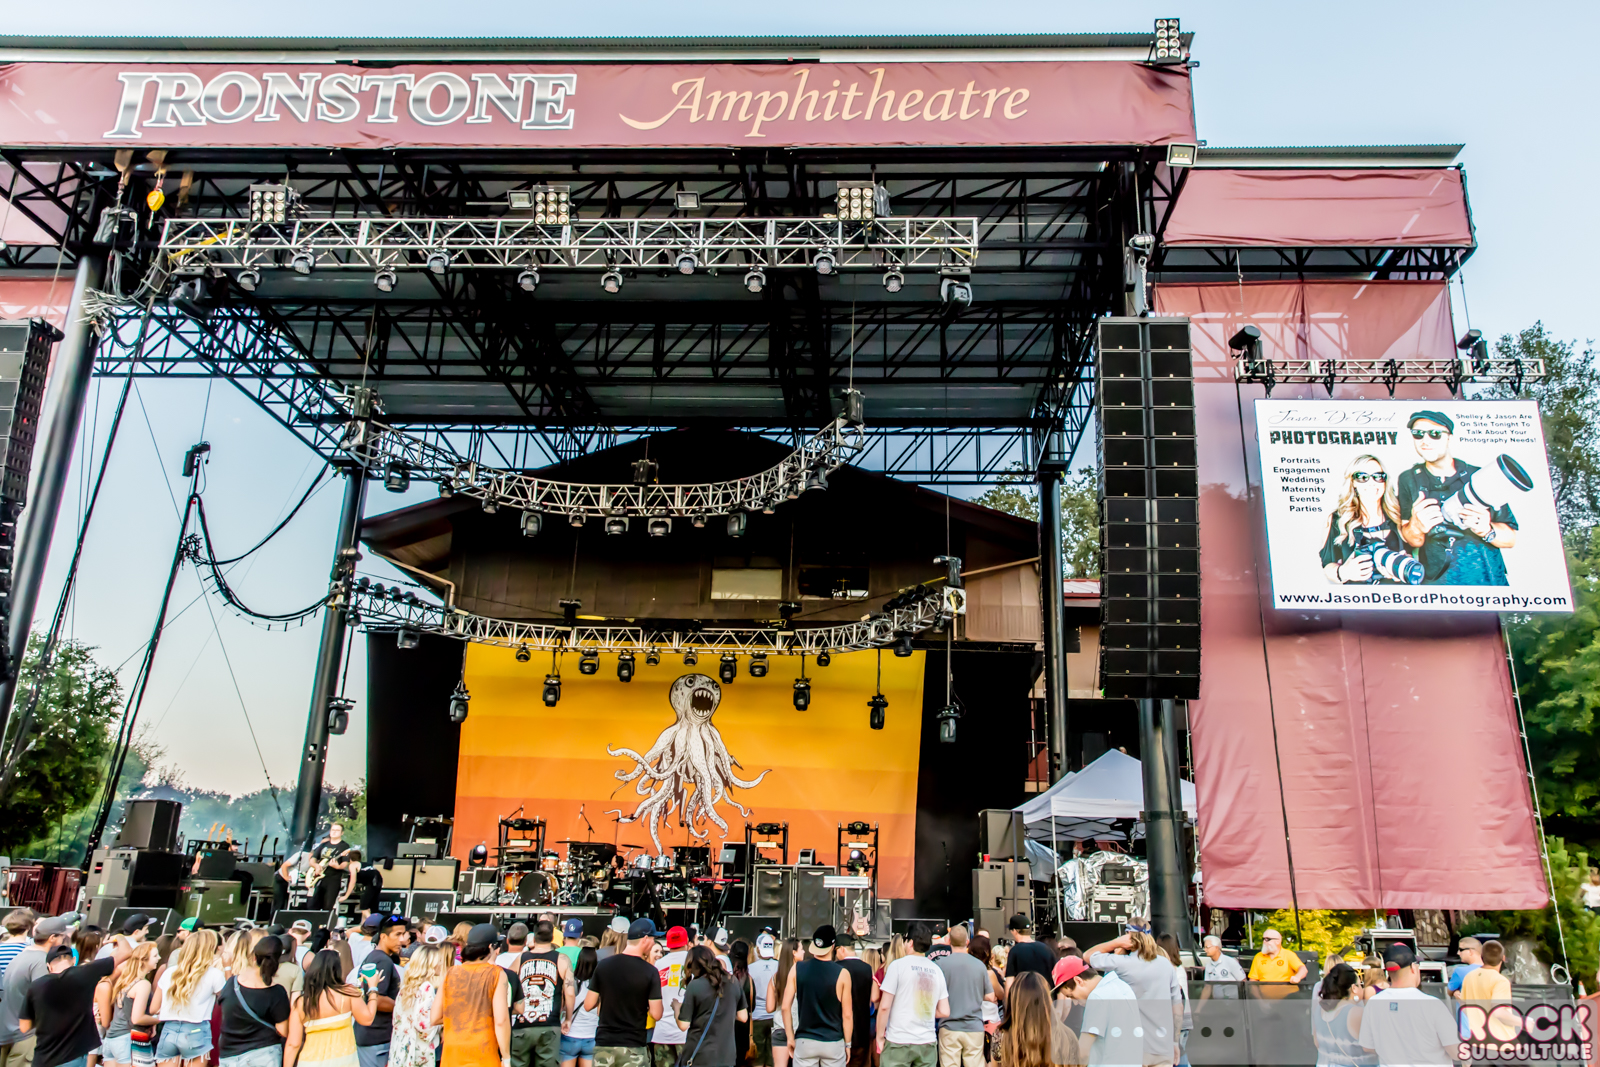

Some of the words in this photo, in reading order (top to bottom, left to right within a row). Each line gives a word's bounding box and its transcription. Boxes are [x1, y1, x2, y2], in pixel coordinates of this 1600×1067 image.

[103, 71, 577, 139] IRONSTONE
[619, 68, 1029, 138] Amphitheatre
[1268, 409, 1318, 424] Jason
[1269, 430, 1398, 445] PHOTOGRAPHY
[1280, 456, 1321, 464] Portraits
[1273, 466, 1331, 475] Engagement
[1280, 476, 1325, 485] Weddings
[1281, 485, 1326, 494] Maternity
[1279, 592, 1567, 607] www.JasonDeBordPhotography.com
